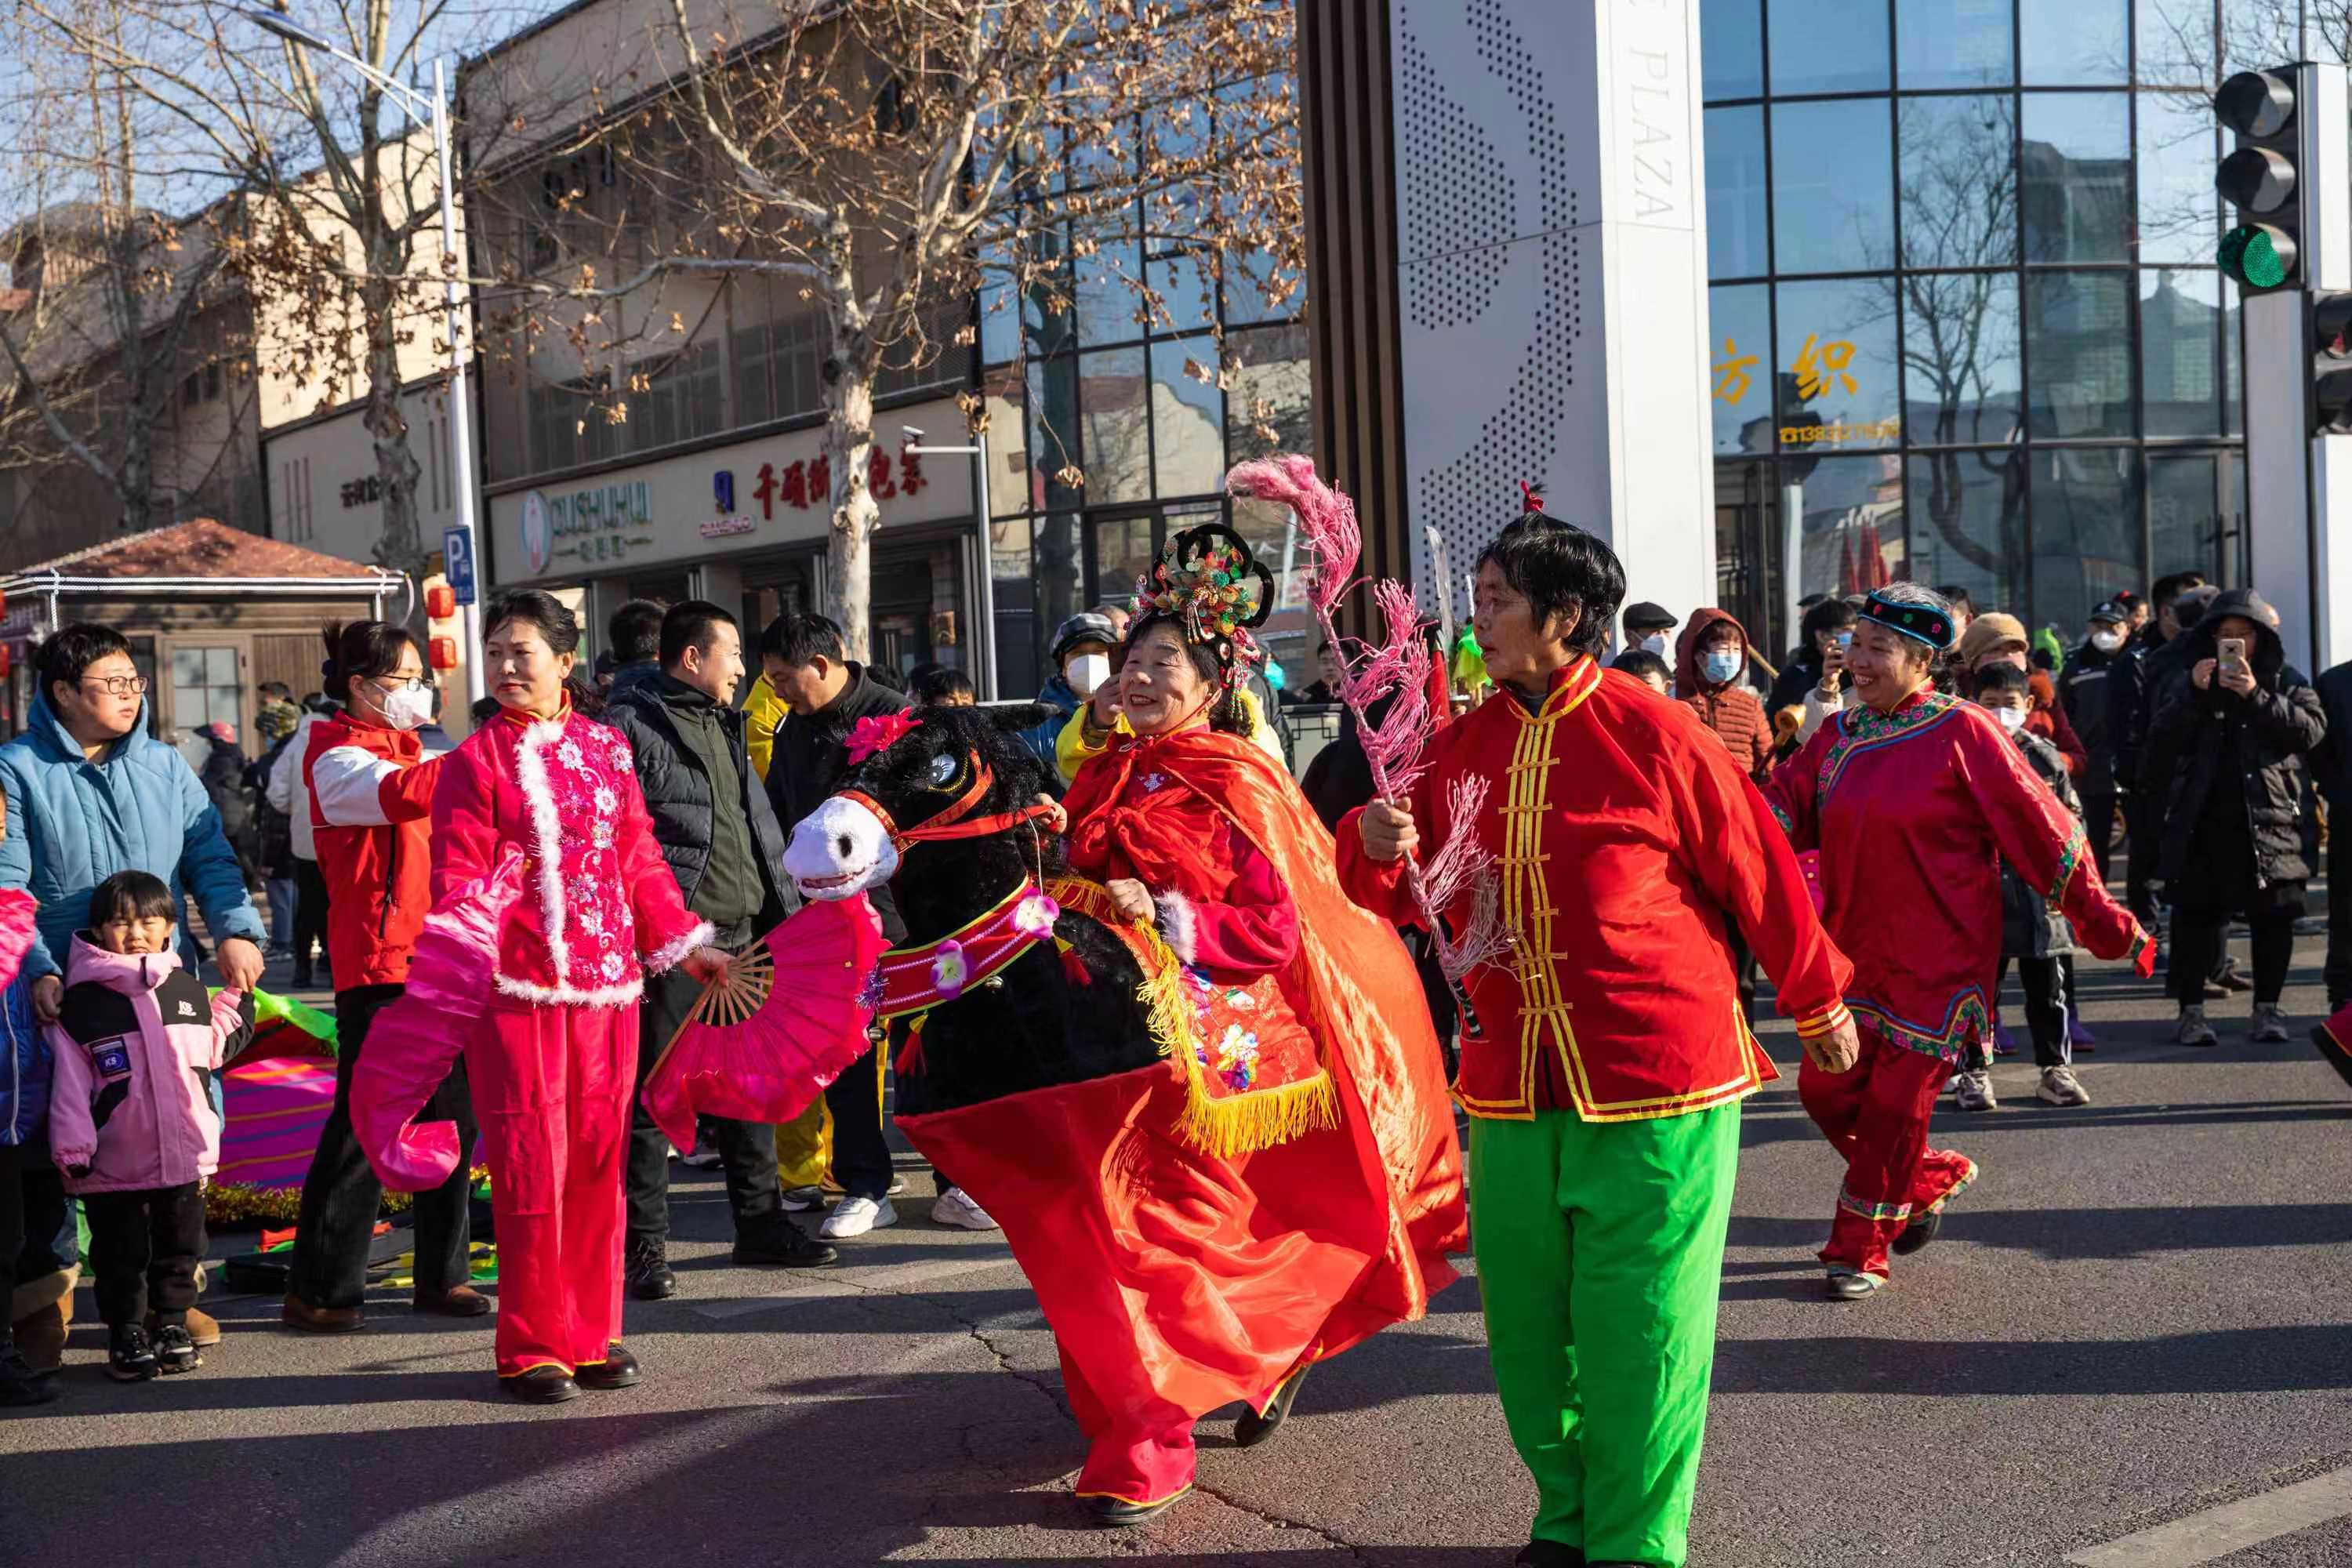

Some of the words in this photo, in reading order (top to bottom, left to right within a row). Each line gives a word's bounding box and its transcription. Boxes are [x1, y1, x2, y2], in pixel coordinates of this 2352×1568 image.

[1629, 46, 1675, 220] PLAZA
[448, 535, 464, 581] P
[105, 1057, 117, 1067] KS
